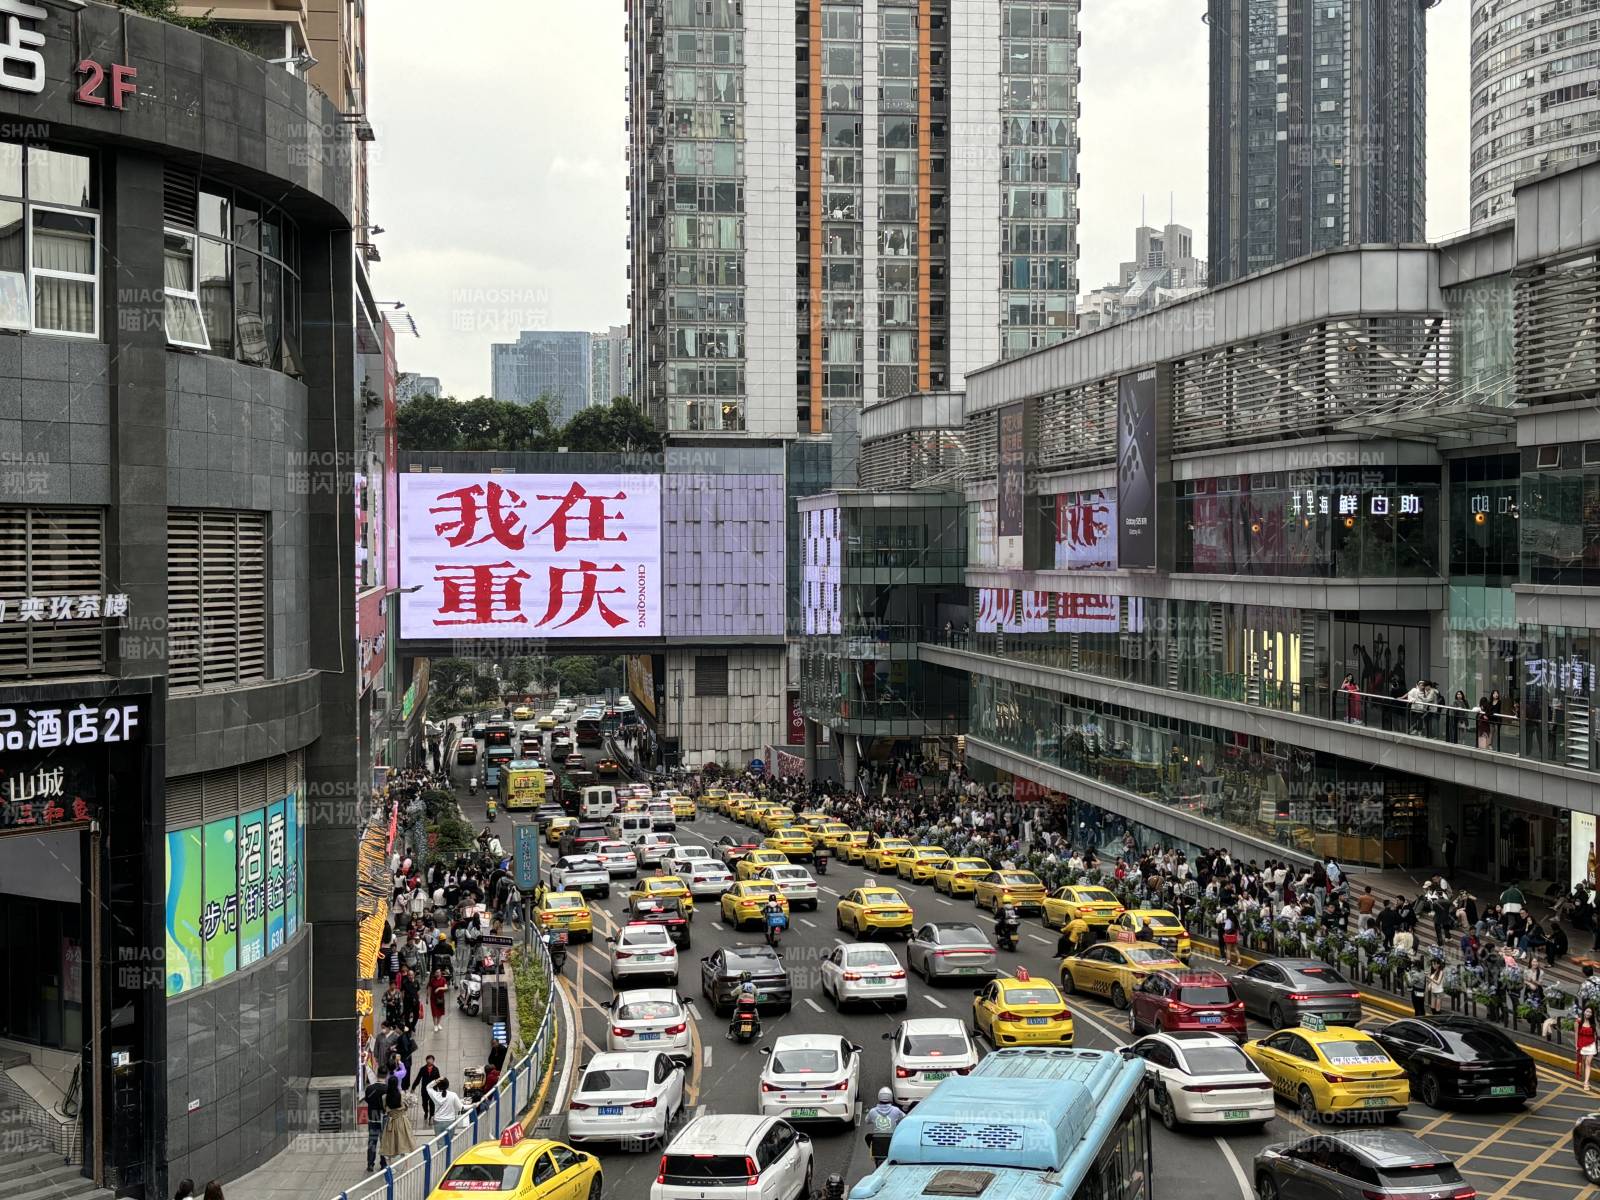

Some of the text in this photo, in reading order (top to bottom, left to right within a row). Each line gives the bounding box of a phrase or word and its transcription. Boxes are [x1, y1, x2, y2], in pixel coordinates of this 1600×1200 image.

[75, 60, 136, 110] 2F
[428, 481, 629, 551] 我在
[432, 559, 630, 630] 重庆
[637, 564, 646, 628] CHONGQING
[9, 766, 65, 801] 山城
[240, 814, 284, 885] 招商
